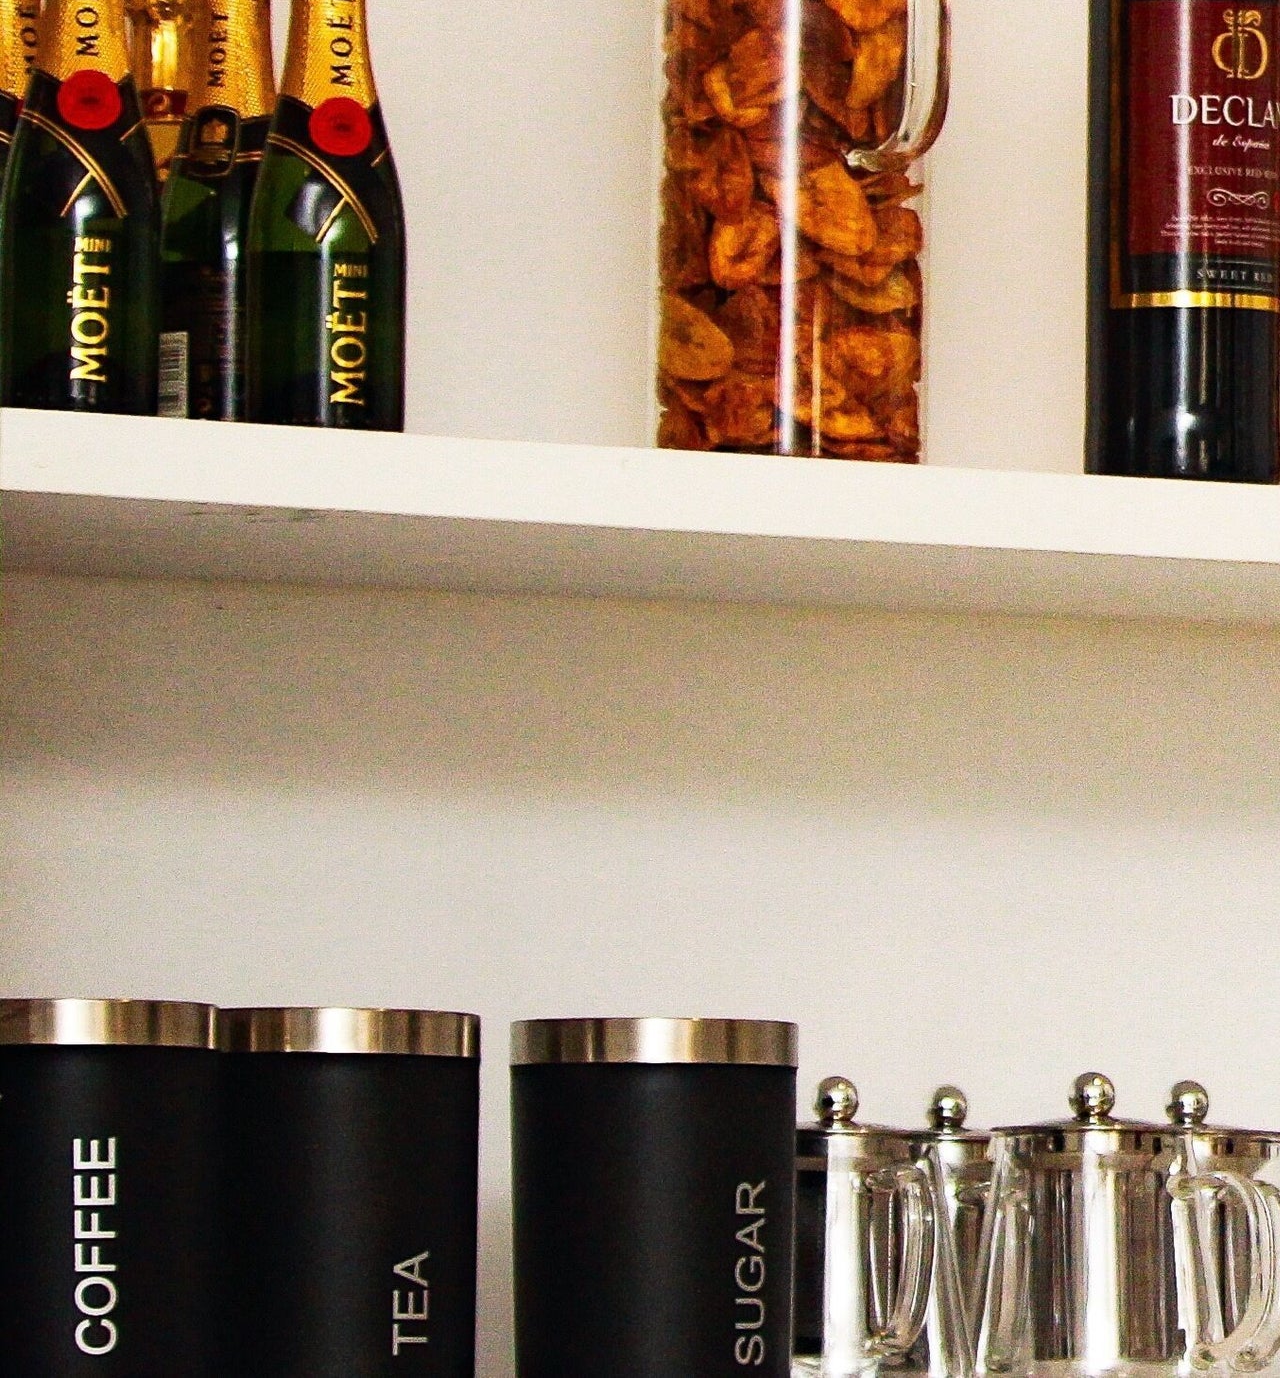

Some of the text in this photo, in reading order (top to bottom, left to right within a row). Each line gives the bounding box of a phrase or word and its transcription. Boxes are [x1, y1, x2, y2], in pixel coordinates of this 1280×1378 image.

[66, 252, 111, 383] MOËT
[325, 279, 368, 406] MOËT
[73, 1136, 118, 1356] COFFEE
[392, 1250, 430, 1356] TEA
[733, 1179, 767, 1367] SUGAR
